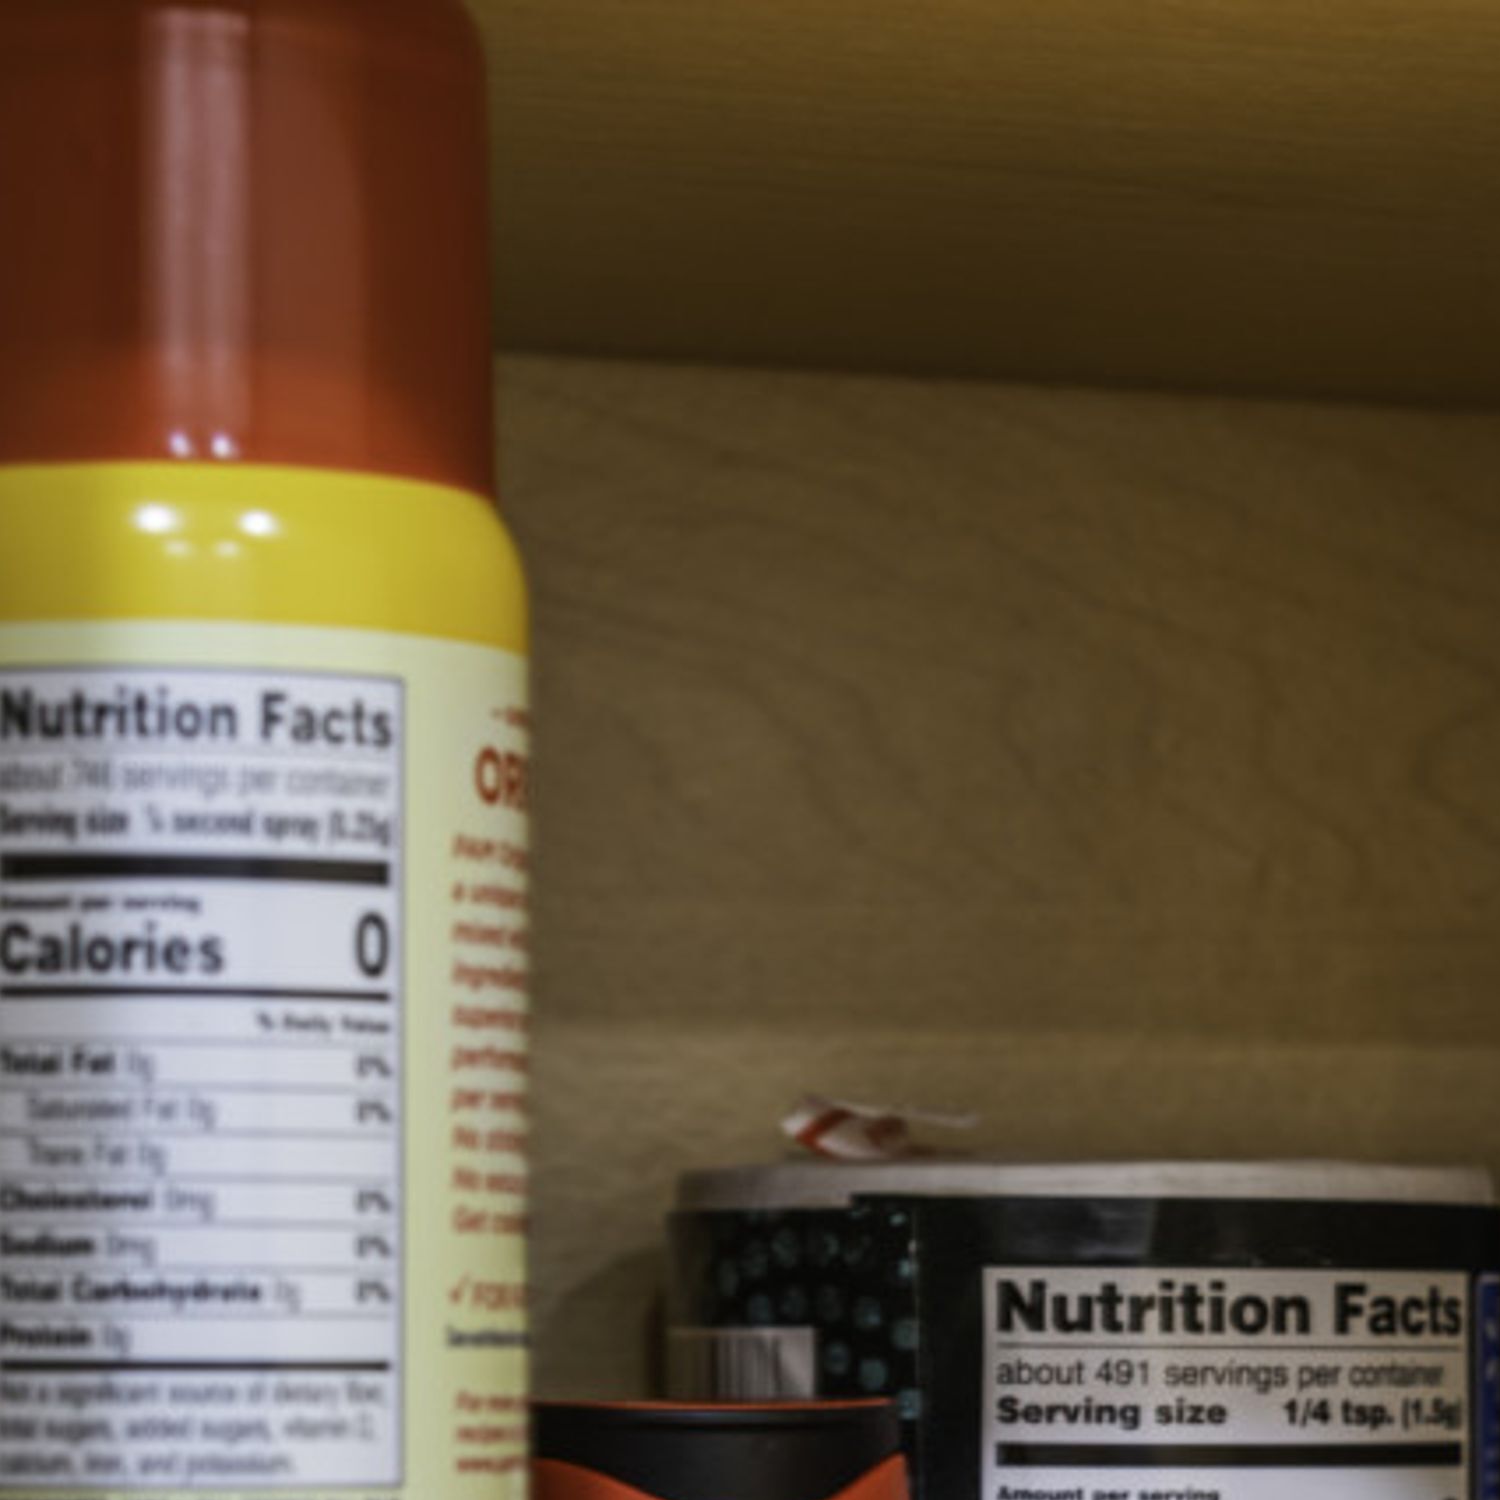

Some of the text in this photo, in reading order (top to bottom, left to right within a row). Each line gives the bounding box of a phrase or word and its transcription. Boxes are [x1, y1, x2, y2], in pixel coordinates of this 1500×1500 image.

[0, 684, 392, 748] Nutrition Facts
[122, 761, 229, 799] servings
[239, 766, 278, 798] per
[286, 766, 390, 797] container
[0, 911, 390, 979] Calories 0
[996, 1280, 1464, 1338] Nutrition Facts
[996, 1359, 1444, 1395] about 491 servings per container
[996, 1395, 1143, 1431] Serving
[1154, 1396, 1229, 1425] size
[1283, 1398, 1331, 1427] 1/4
[1341, 1398, 1395, 1430] tsp.
